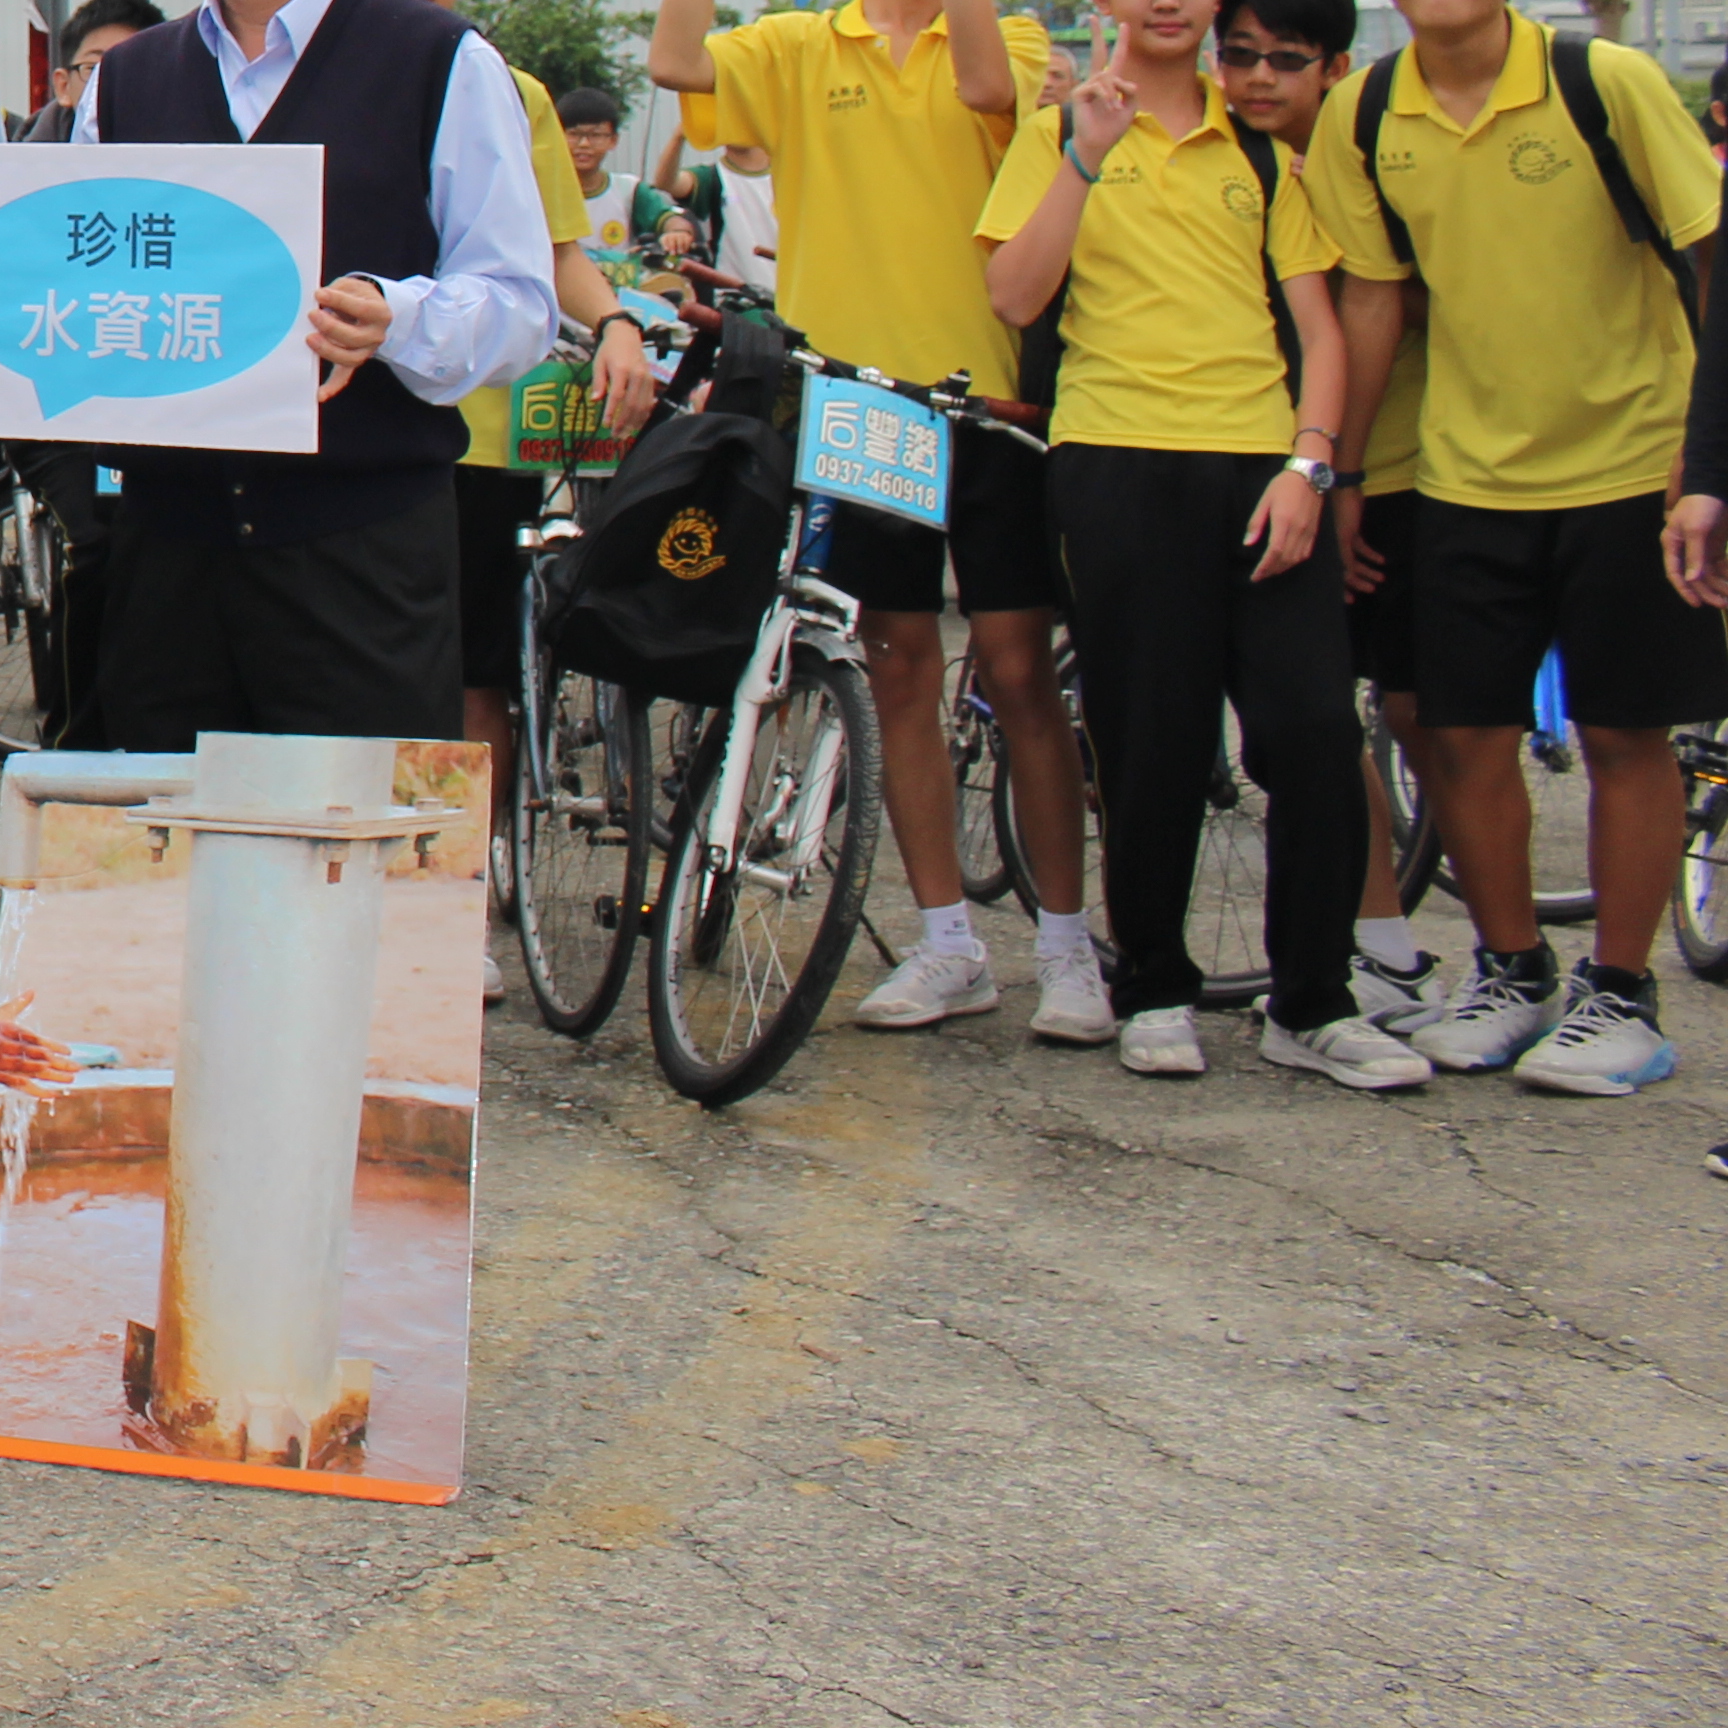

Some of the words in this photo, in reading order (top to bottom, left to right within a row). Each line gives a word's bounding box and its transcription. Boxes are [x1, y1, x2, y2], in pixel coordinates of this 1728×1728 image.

[65, 211, 177, 270] 珍惜
[18, 288, 224, 363] 水資源
[814, 452, 938, 511] 0937-460918
